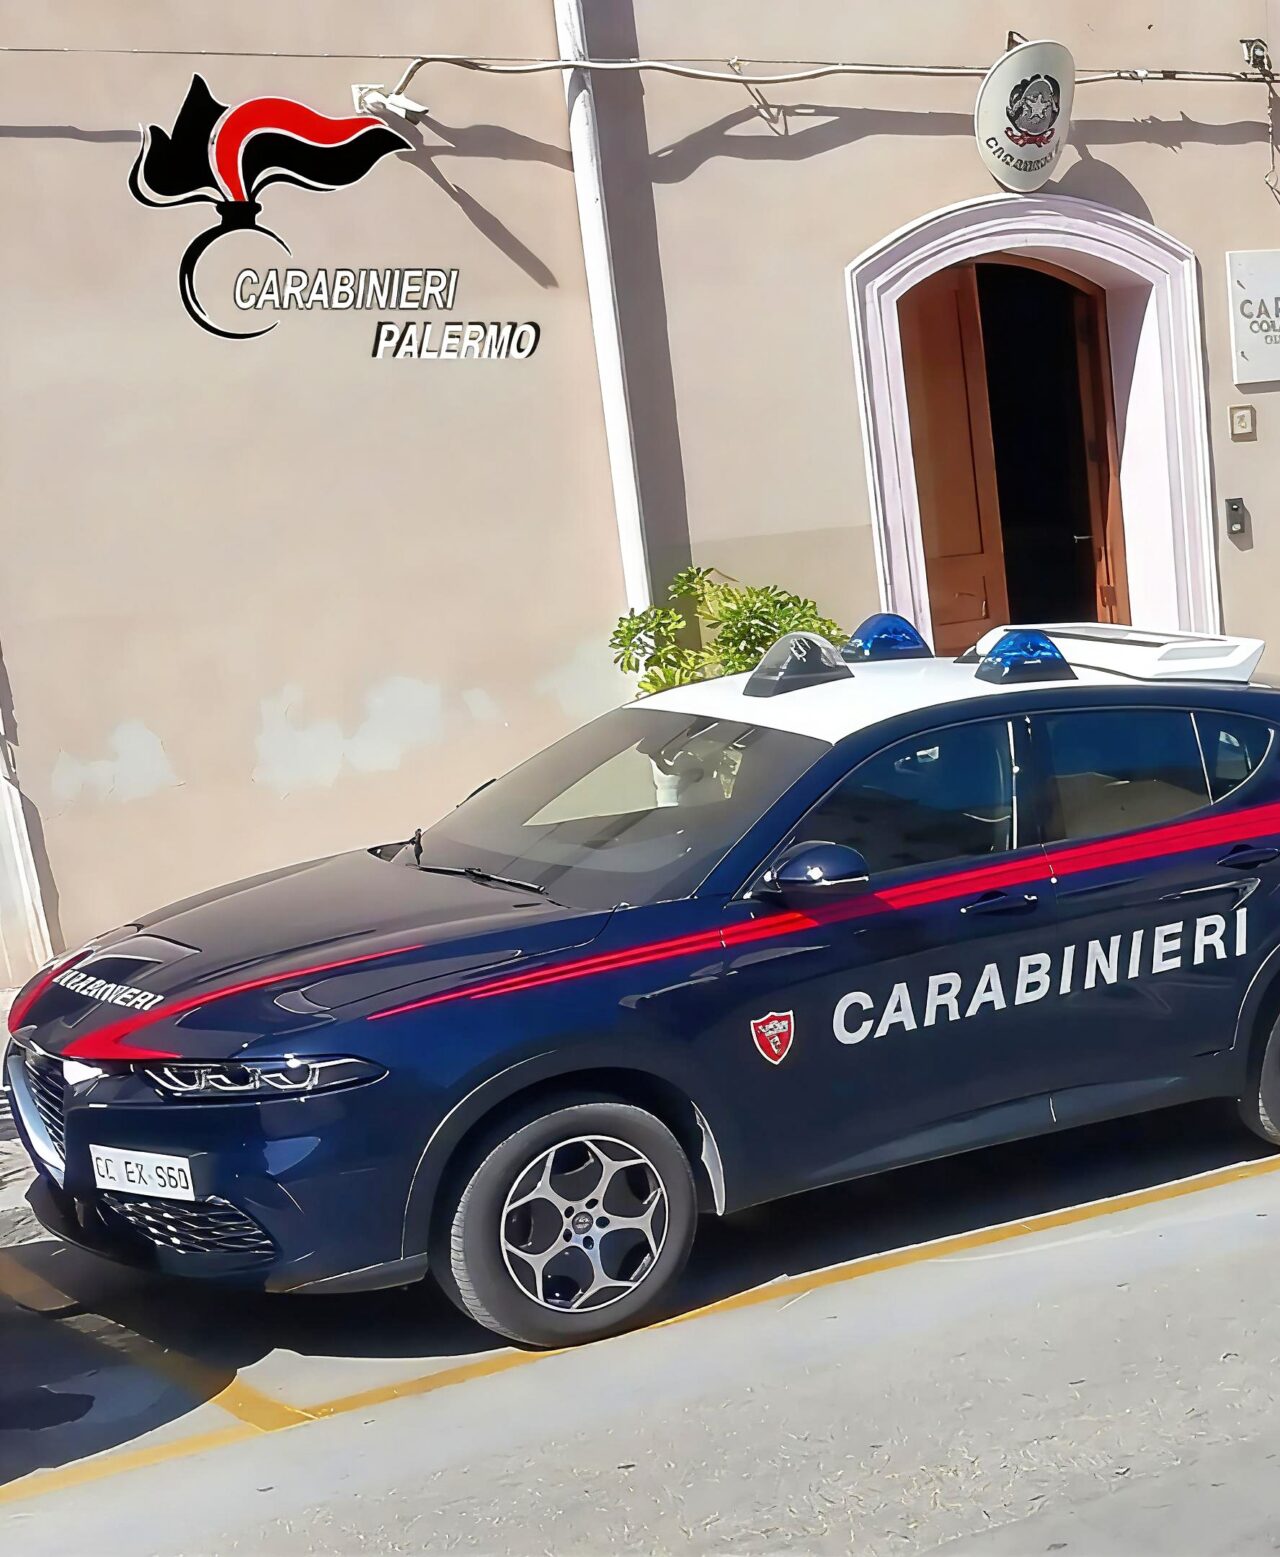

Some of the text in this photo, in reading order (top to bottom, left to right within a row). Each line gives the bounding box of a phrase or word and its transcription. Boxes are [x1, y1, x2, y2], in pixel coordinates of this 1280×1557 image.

[832, 907, 1248, 1045] CARABINIERI
[95, 1156, 117, 1182] CC
[124, 1161, 149, 1186] EX
